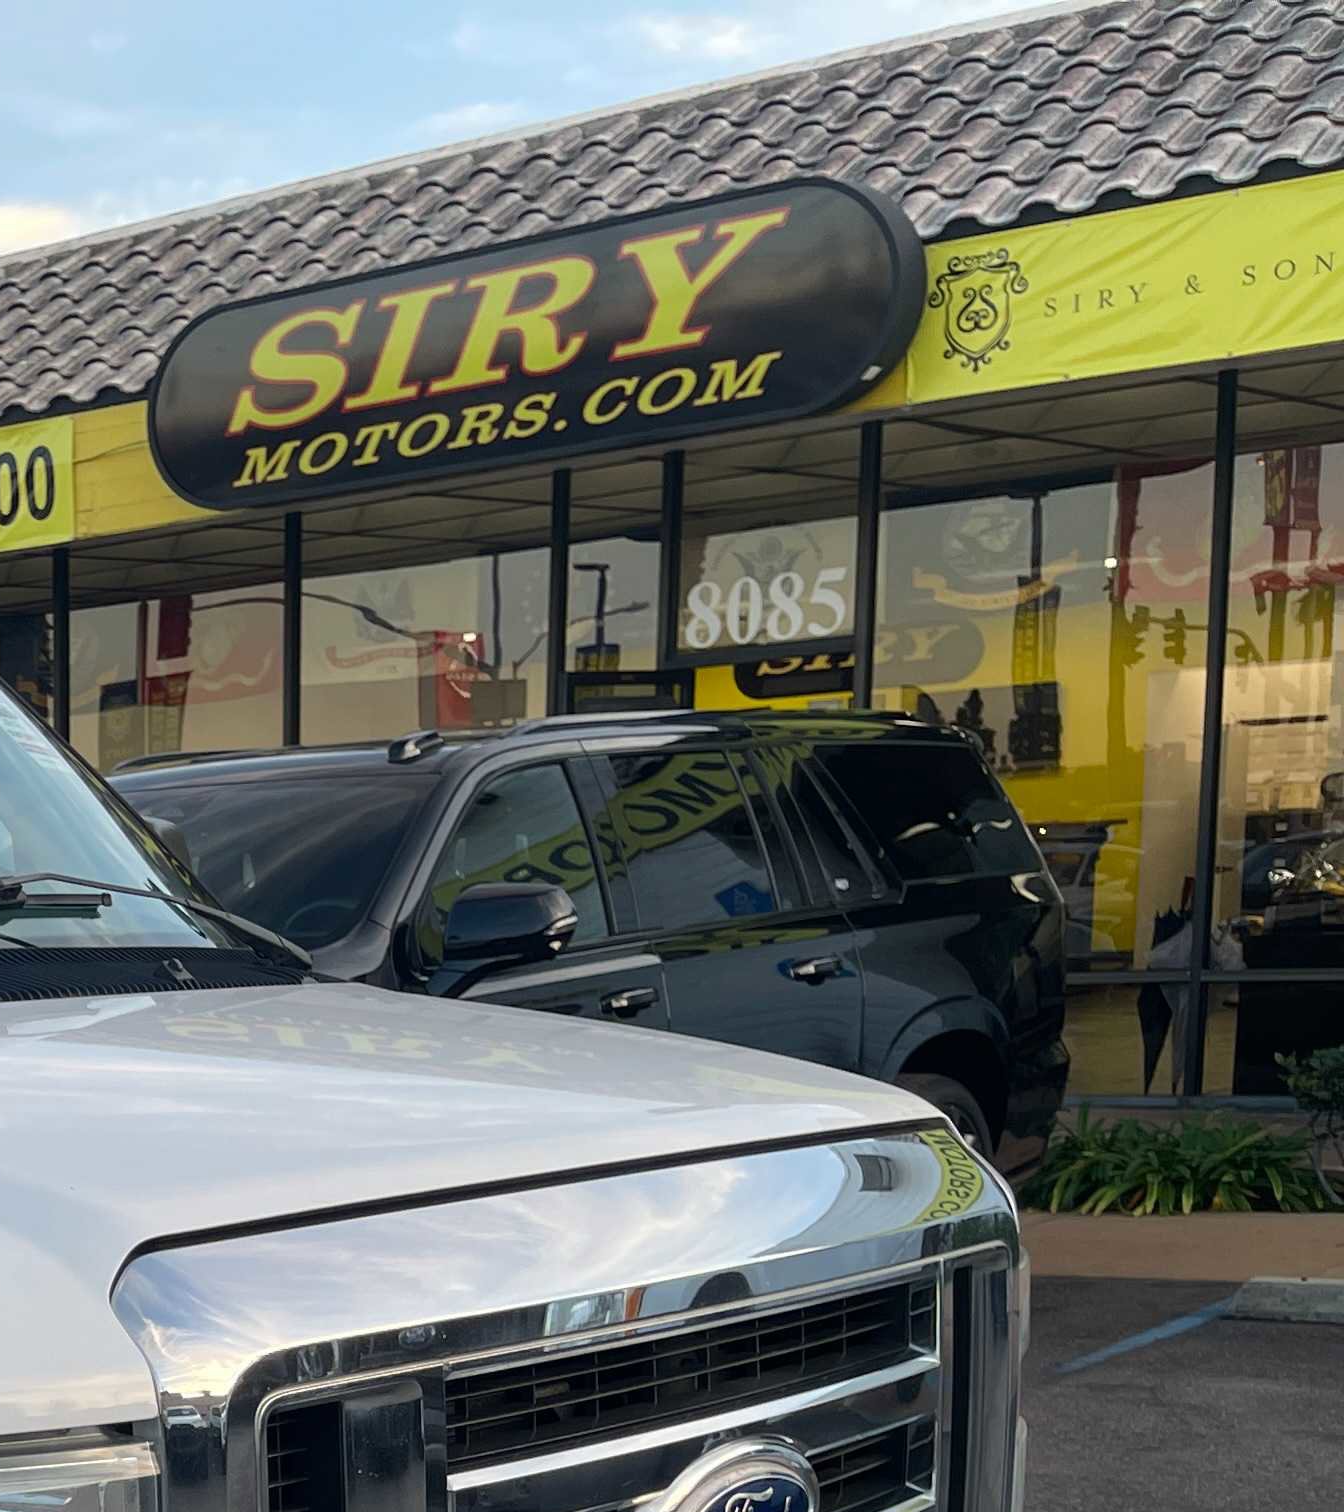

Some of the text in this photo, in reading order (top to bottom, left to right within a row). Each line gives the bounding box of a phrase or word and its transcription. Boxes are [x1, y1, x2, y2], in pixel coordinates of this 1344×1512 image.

[225, 206, 791, 437] SIRY
[1043, 282, 1148, 318] SIRY
[1184, 274, 1205, 295] &
[232, 351, 784, 488] MOTORS.COM
[685, 567, 848, 649] 8085
